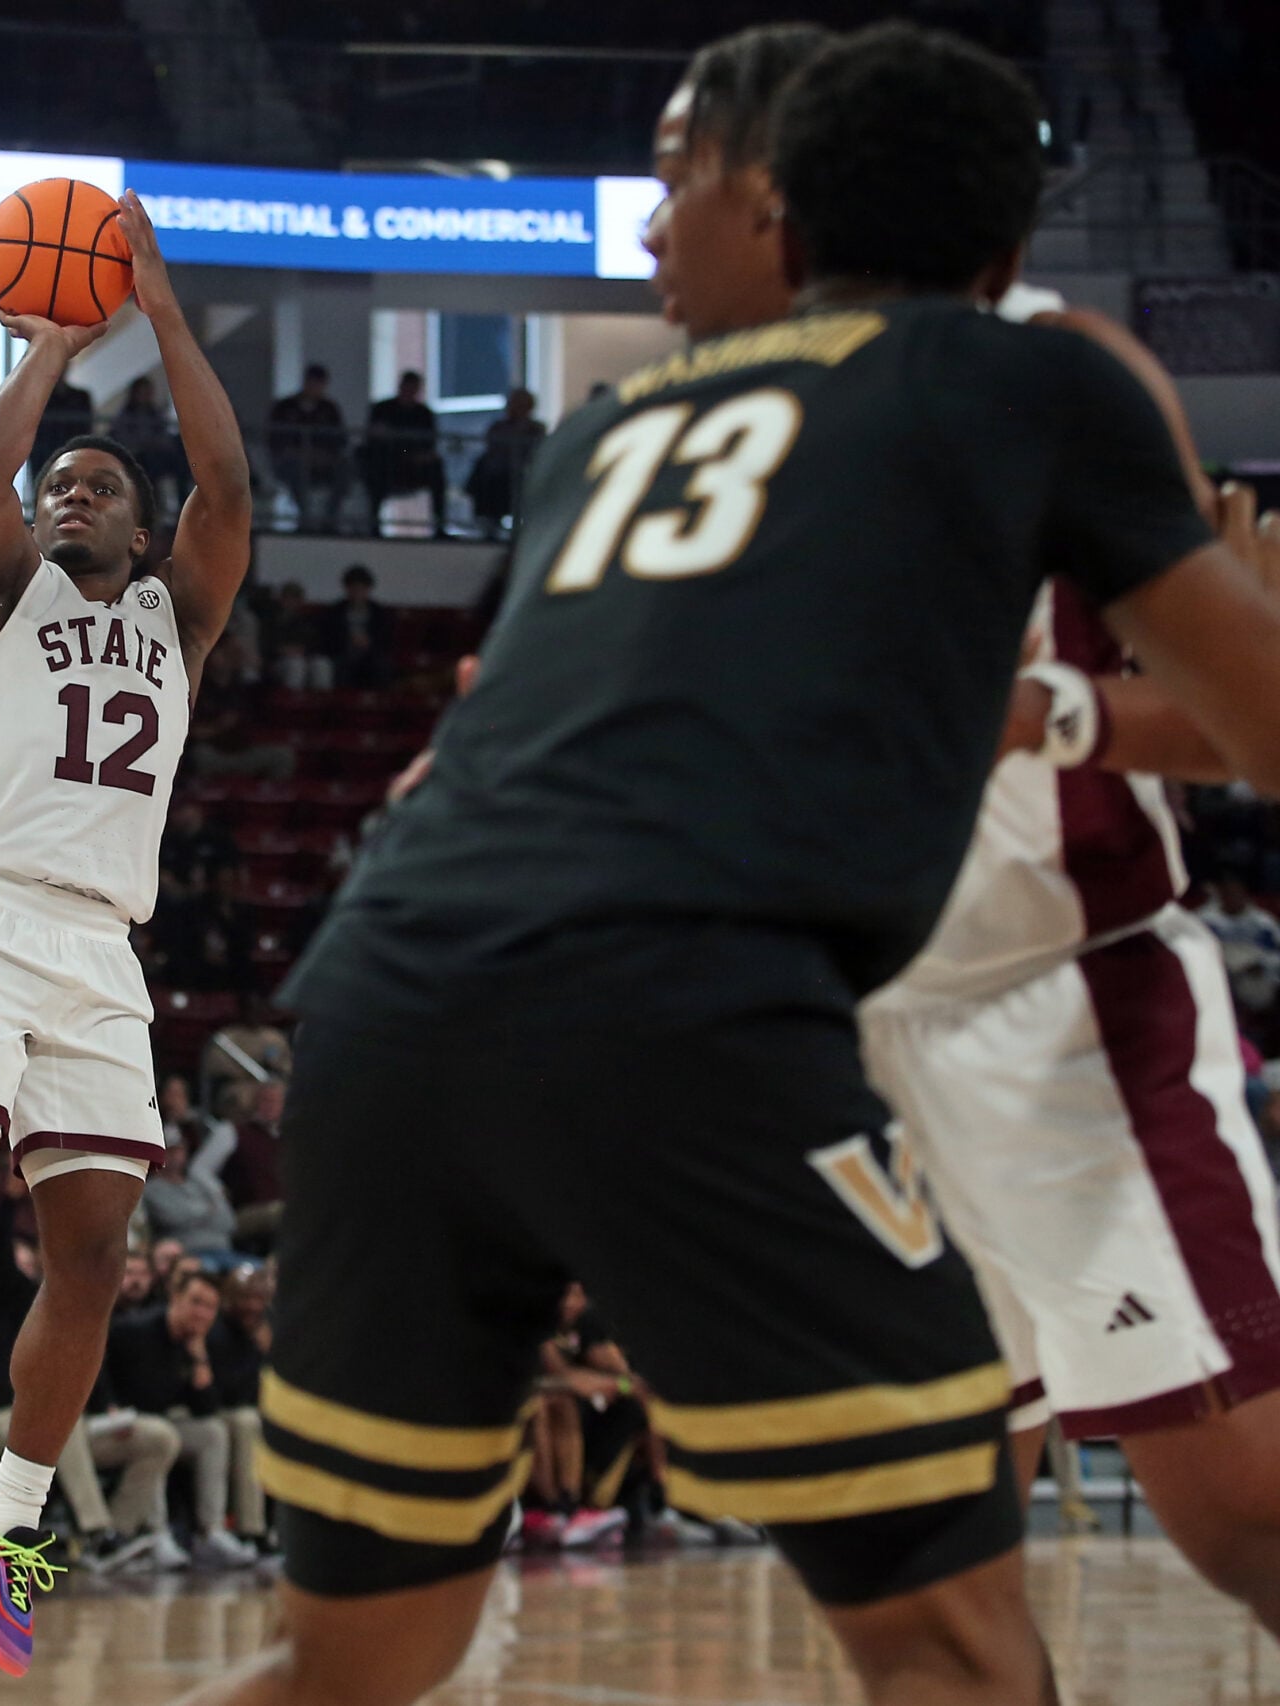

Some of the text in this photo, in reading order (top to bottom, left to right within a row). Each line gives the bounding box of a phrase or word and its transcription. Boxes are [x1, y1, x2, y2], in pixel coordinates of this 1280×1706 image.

[342, 205, 370, 240] &
[373, 206, 594, 244] COMMERCIAL
[544, 386, 804, 595] 13
[37, 616, 168, 690] STATE
[54, 683, 160, 797] 12
